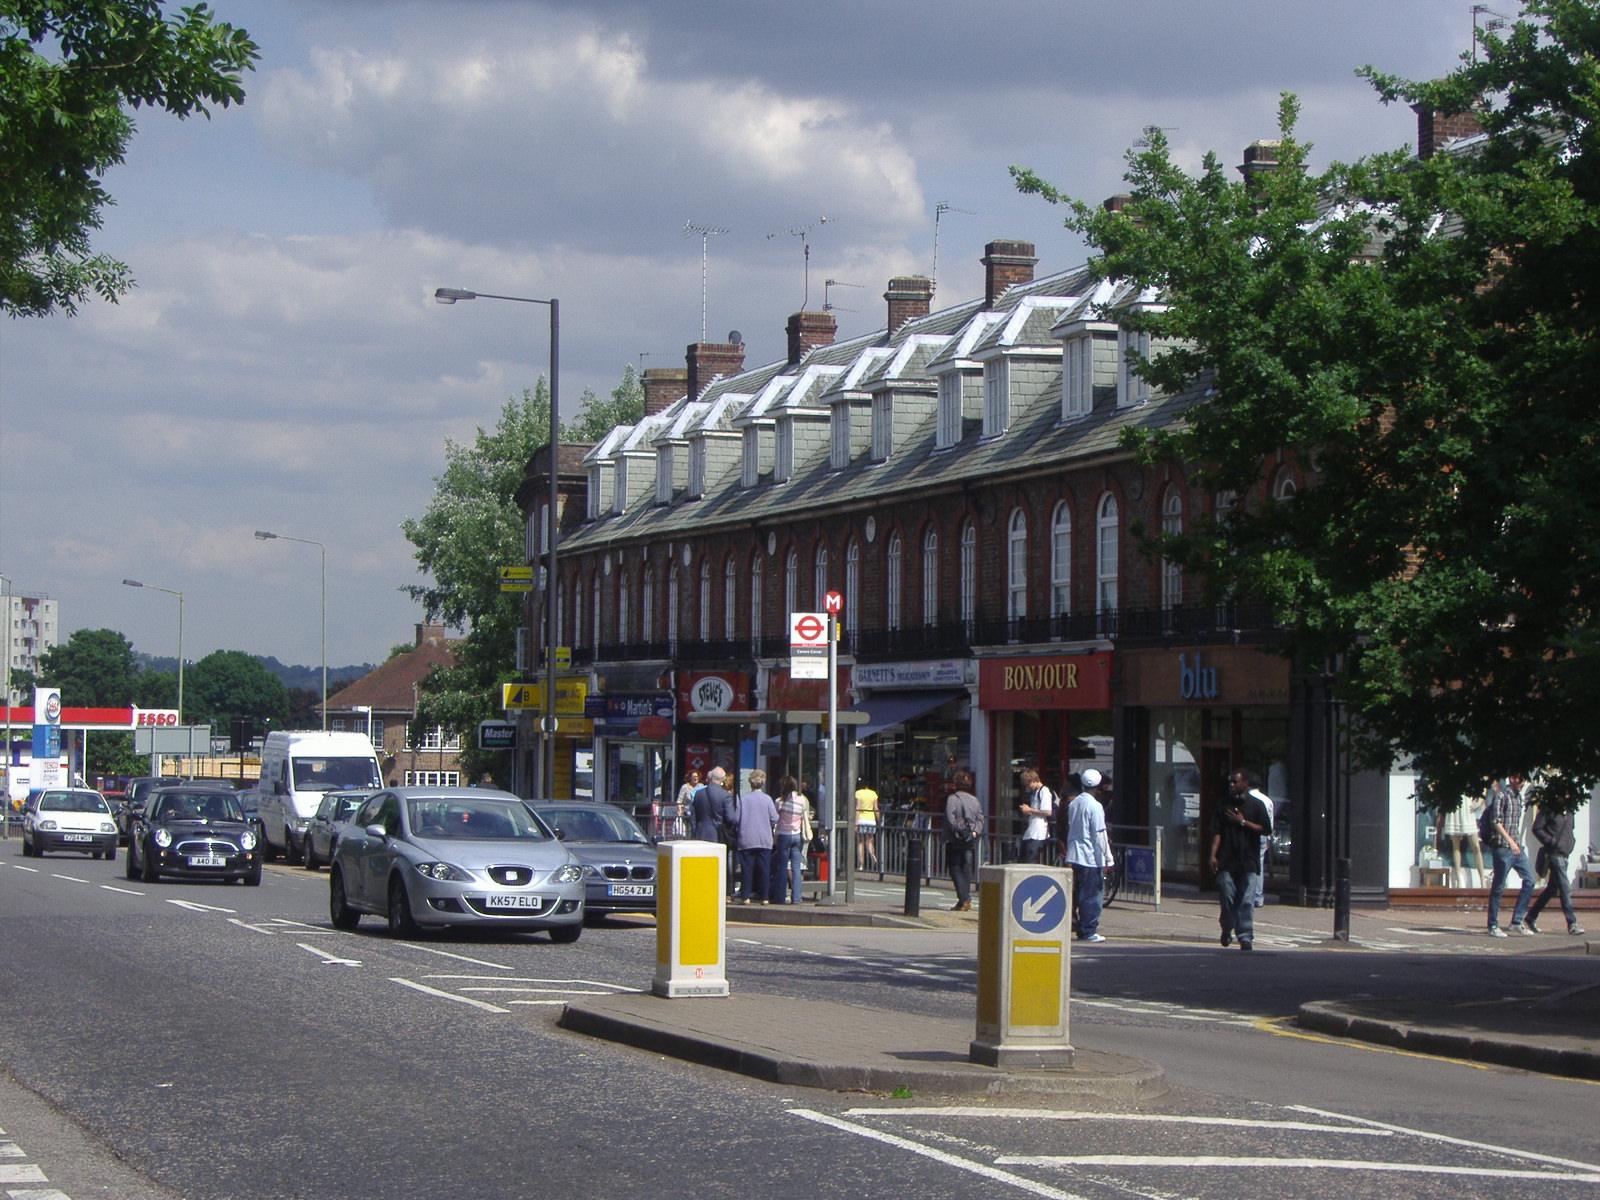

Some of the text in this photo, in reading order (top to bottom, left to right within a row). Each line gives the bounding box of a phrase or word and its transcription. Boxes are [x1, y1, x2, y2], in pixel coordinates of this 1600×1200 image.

[826, 595, 840, 609] M
[1004, 663, 1077, 690] BONJOUR
[1180, 652, 1217, 699] blu
[699, 680, 723, 708] STEVE'S
[138, 713, 177, 725] ESSO
[613, 885, 635, 895] HG54
[490, 896, 538, 907] KK57 ELO
